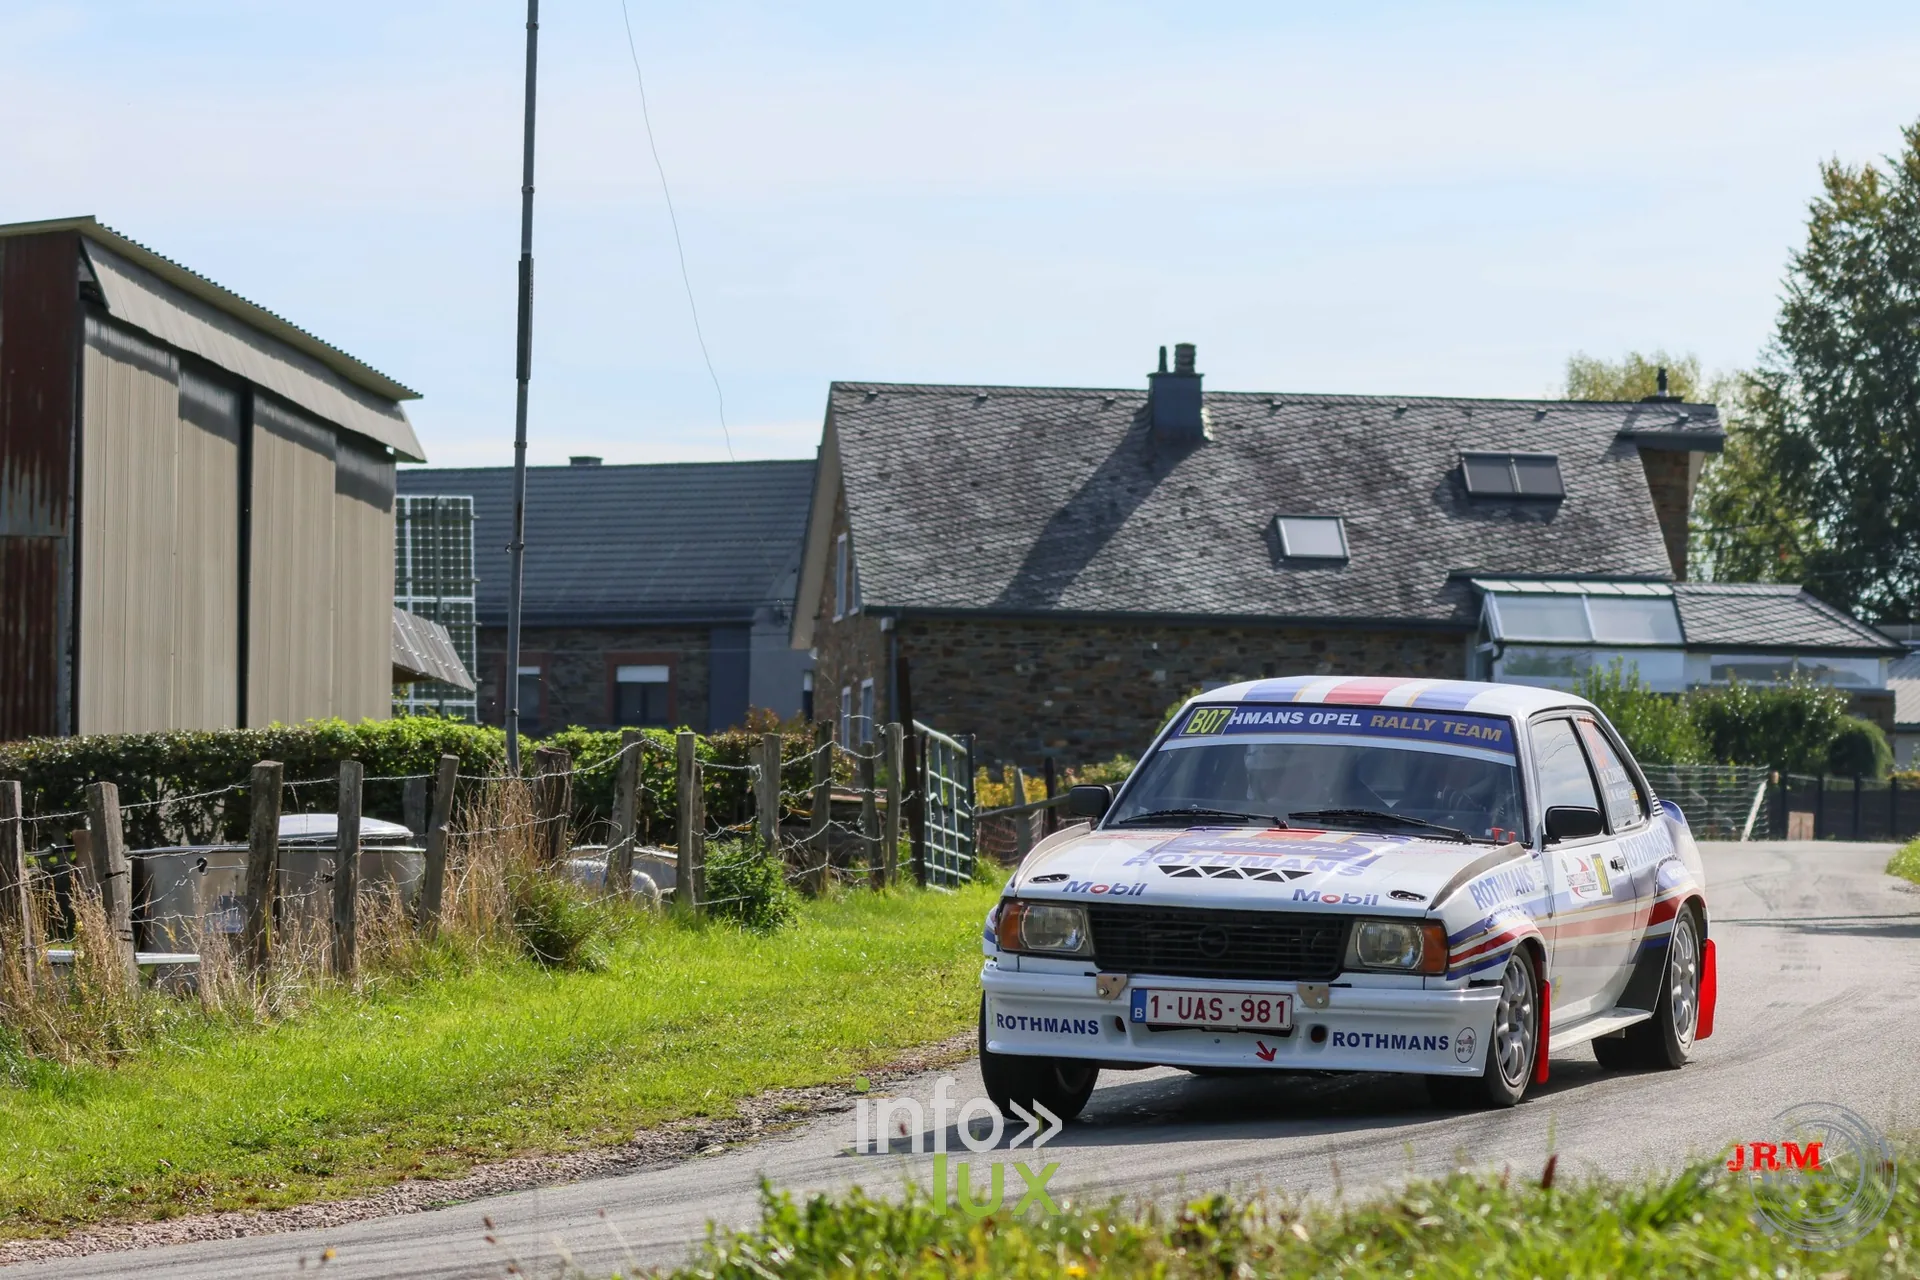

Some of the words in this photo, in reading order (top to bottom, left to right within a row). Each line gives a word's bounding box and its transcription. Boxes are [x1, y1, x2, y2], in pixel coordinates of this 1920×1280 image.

[1186, 709, 1231, 734] B07
[1228, 711, 1304, 725] HMANS
[1309, 712, 1361, 726] OPEL
[1369, 715, 1436, 732] RALLY
[1443, 720, 1503, 742] TEAM
[1122, 853, 1366, 877] ROTHMANS
[1062, 880, 1148, 897] Mobil
[1292, 888, 1380, 906] Mobil
[1468, 865, 1536, 911] ROTHMANS
[1134, 1007, 1143, 1019] B
[1150, 995, 1285, 1024] 1-UAS-981
[996, 1012, 1099, 1035] ROTHMANS
[1332, 1031, 1449, 1051] ROTHMANS
